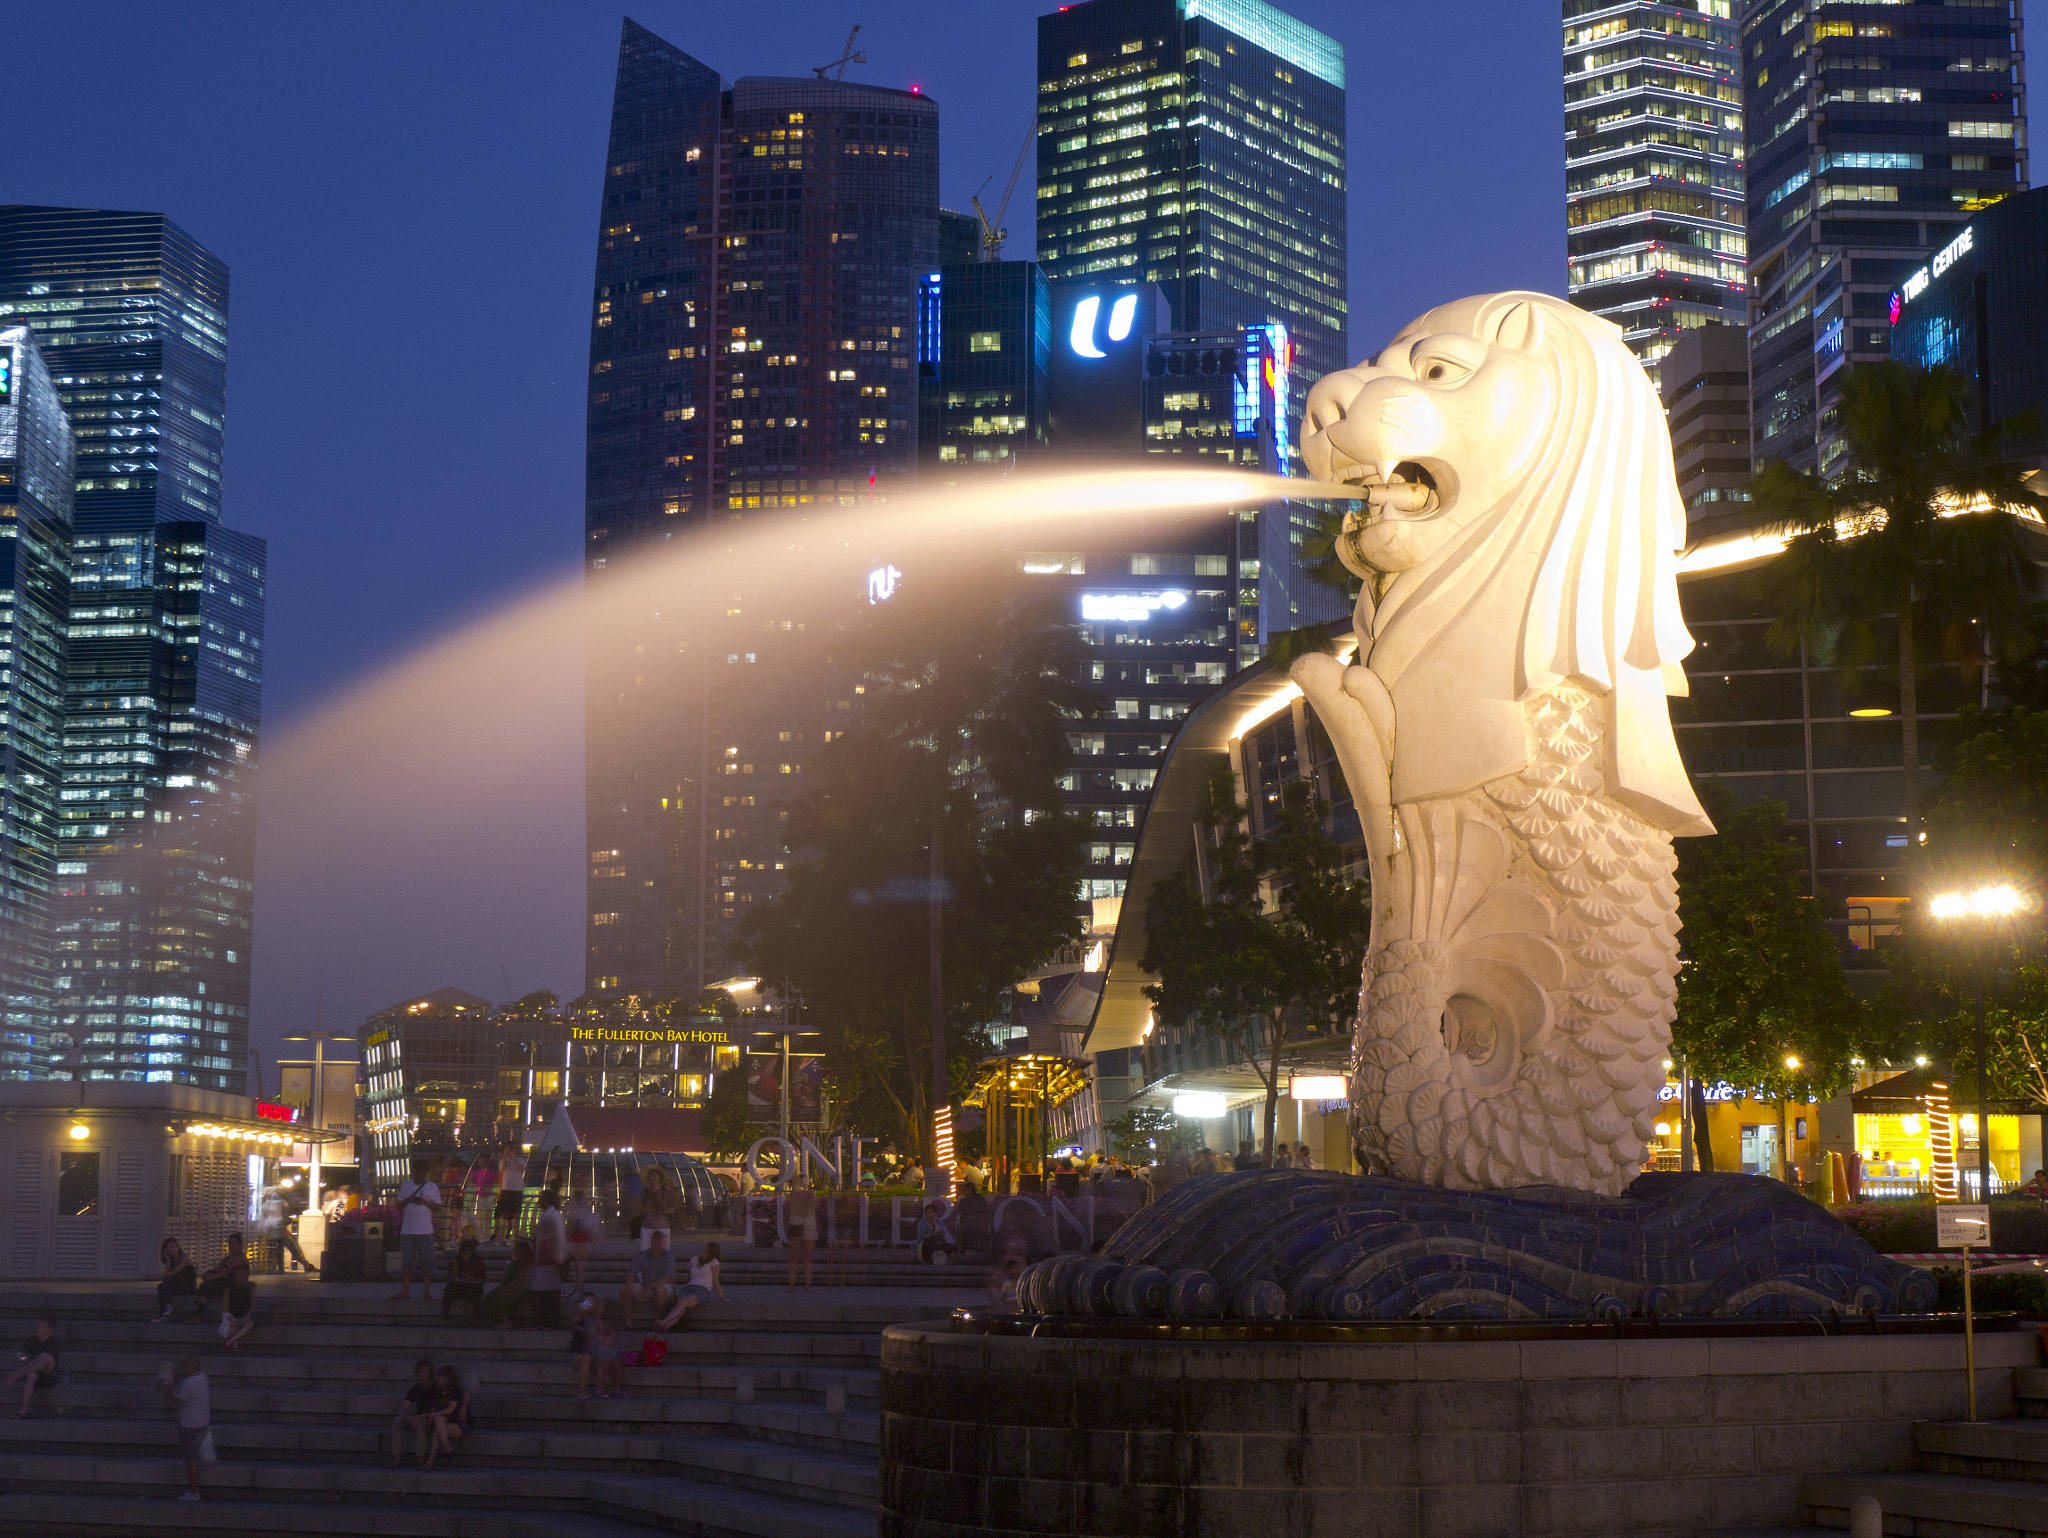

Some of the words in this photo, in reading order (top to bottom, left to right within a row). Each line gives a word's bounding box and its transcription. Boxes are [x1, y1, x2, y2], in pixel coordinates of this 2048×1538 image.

[1932, 225, 1973, 278] CENTRE
[571, 1027, 594, 1040] THE
[597, 1028, 664, 1042] FULLERTON
[667, 1029, 689, 1042] BAY
[691, 1030, 730, 1043] HOTEL
[749, 1136, 879, 1188] ONE
